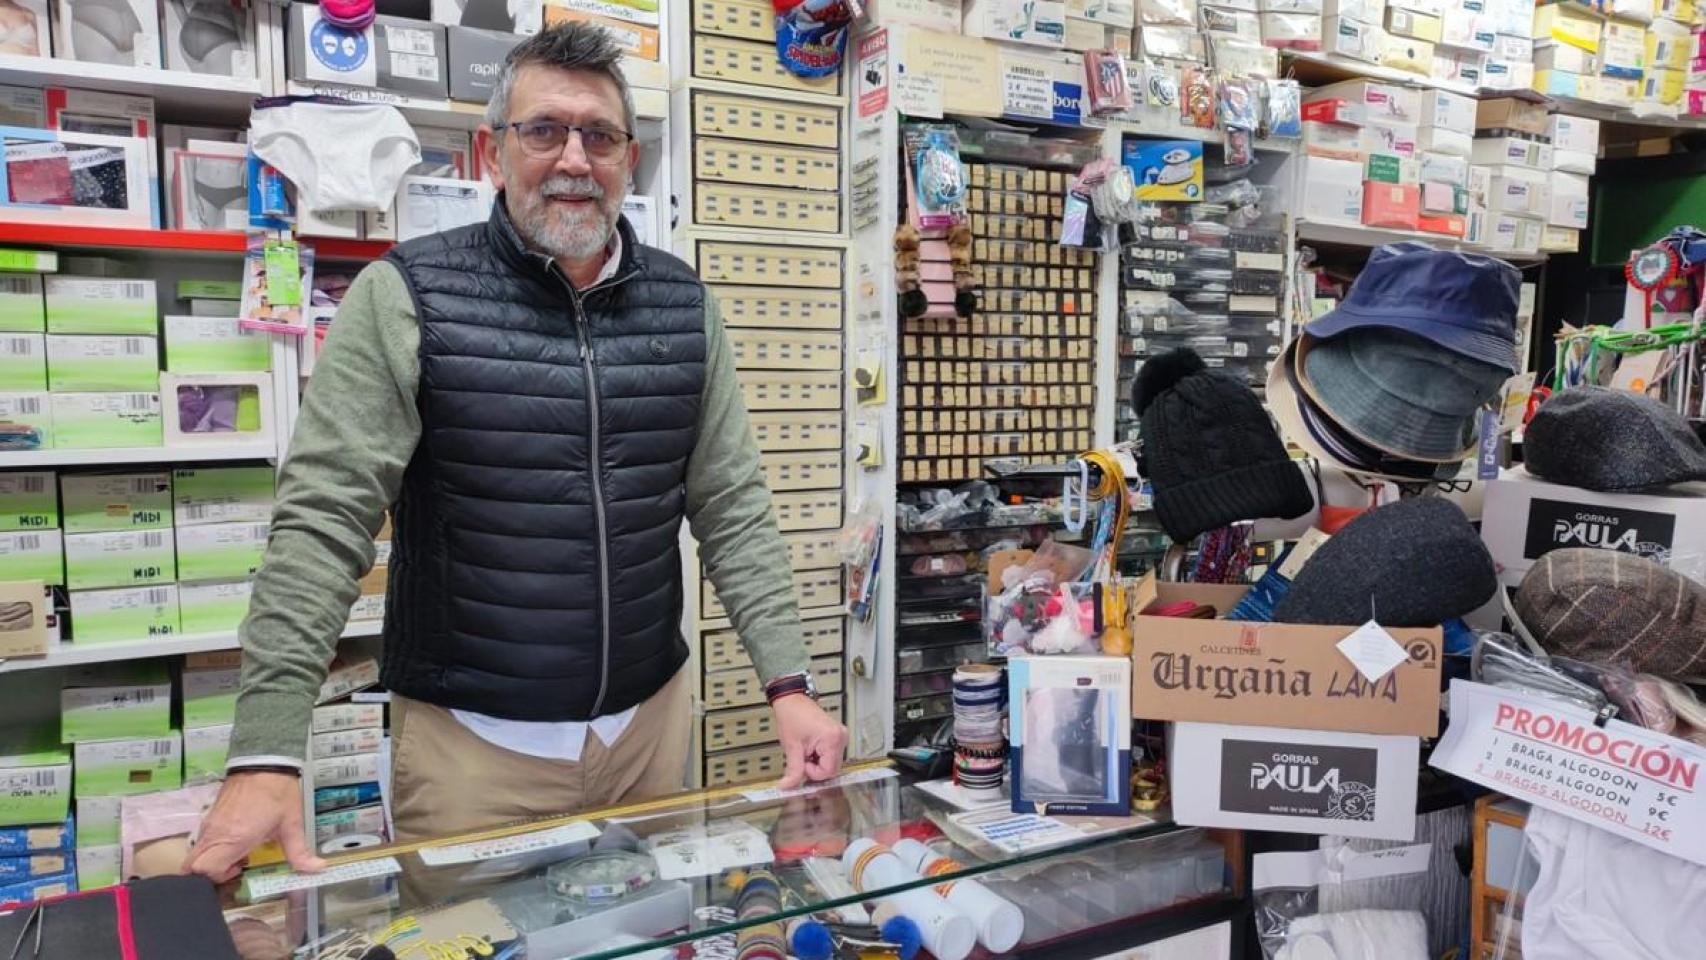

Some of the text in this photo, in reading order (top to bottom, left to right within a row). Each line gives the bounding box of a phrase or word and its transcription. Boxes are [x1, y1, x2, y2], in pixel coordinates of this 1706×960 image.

[19, 515, 48, 526] MIDI
[132, 511, 161, 525] MIDI
[1575, 512, 1620, 526] GORRAS
[1553, 519, 1638, 551] PAULA
[133, 567, 161, 579] MIDI
[148, 624, 174, 636] MIDI
[1151, 650, 1312, 700] Urgaña
[1495, 703, 1699, 788] PROMOCIÓN
[1272, 752, 1319, 765] GORRAS
[1250, 761, 1340, 794] PAULA
[1511, 742, 1553, 764] BRAGA
[1559, 756, 1639, 792] ALGODON
[1656, 791, 1678, 807] 5€
[1505, 757, 1552, 780] BRAGAS
[1556, 775, 1631, 806] ALGODON
[1648, 806, 1669, 822] 9€
[1268, 805, 1289, 813] MADE
[1494, 769, 1549, 797] BRAGAS
[1551, 789, 1628, 825] ALGODON
[1642, 822, 1673, 842] 12€
